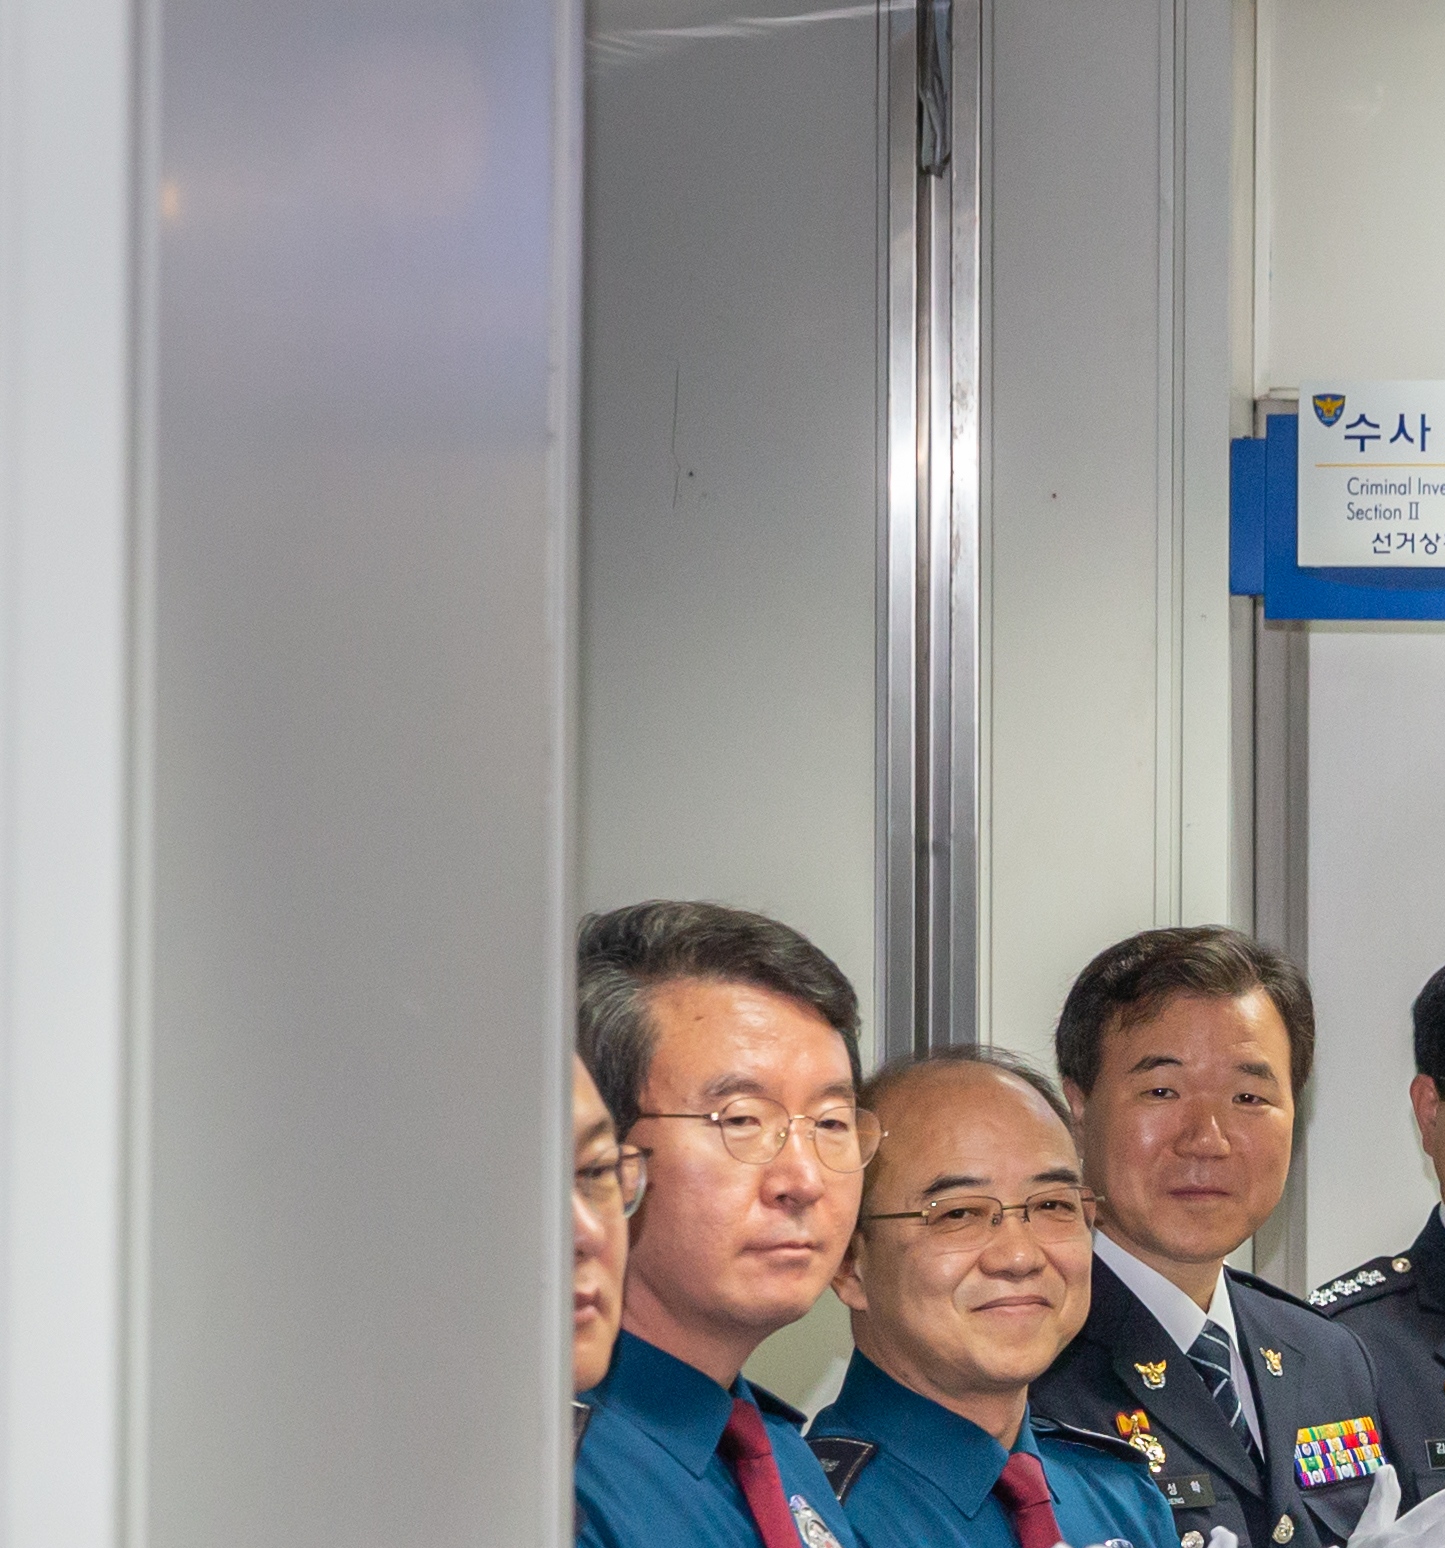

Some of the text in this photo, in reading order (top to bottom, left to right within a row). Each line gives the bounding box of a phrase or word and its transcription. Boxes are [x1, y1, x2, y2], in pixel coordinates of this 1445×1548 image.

[1344, 413, 1431, 453] 수사
[1346, 476, 1412, 496] Criminal
[1346, 502, 1402, 521] Section
